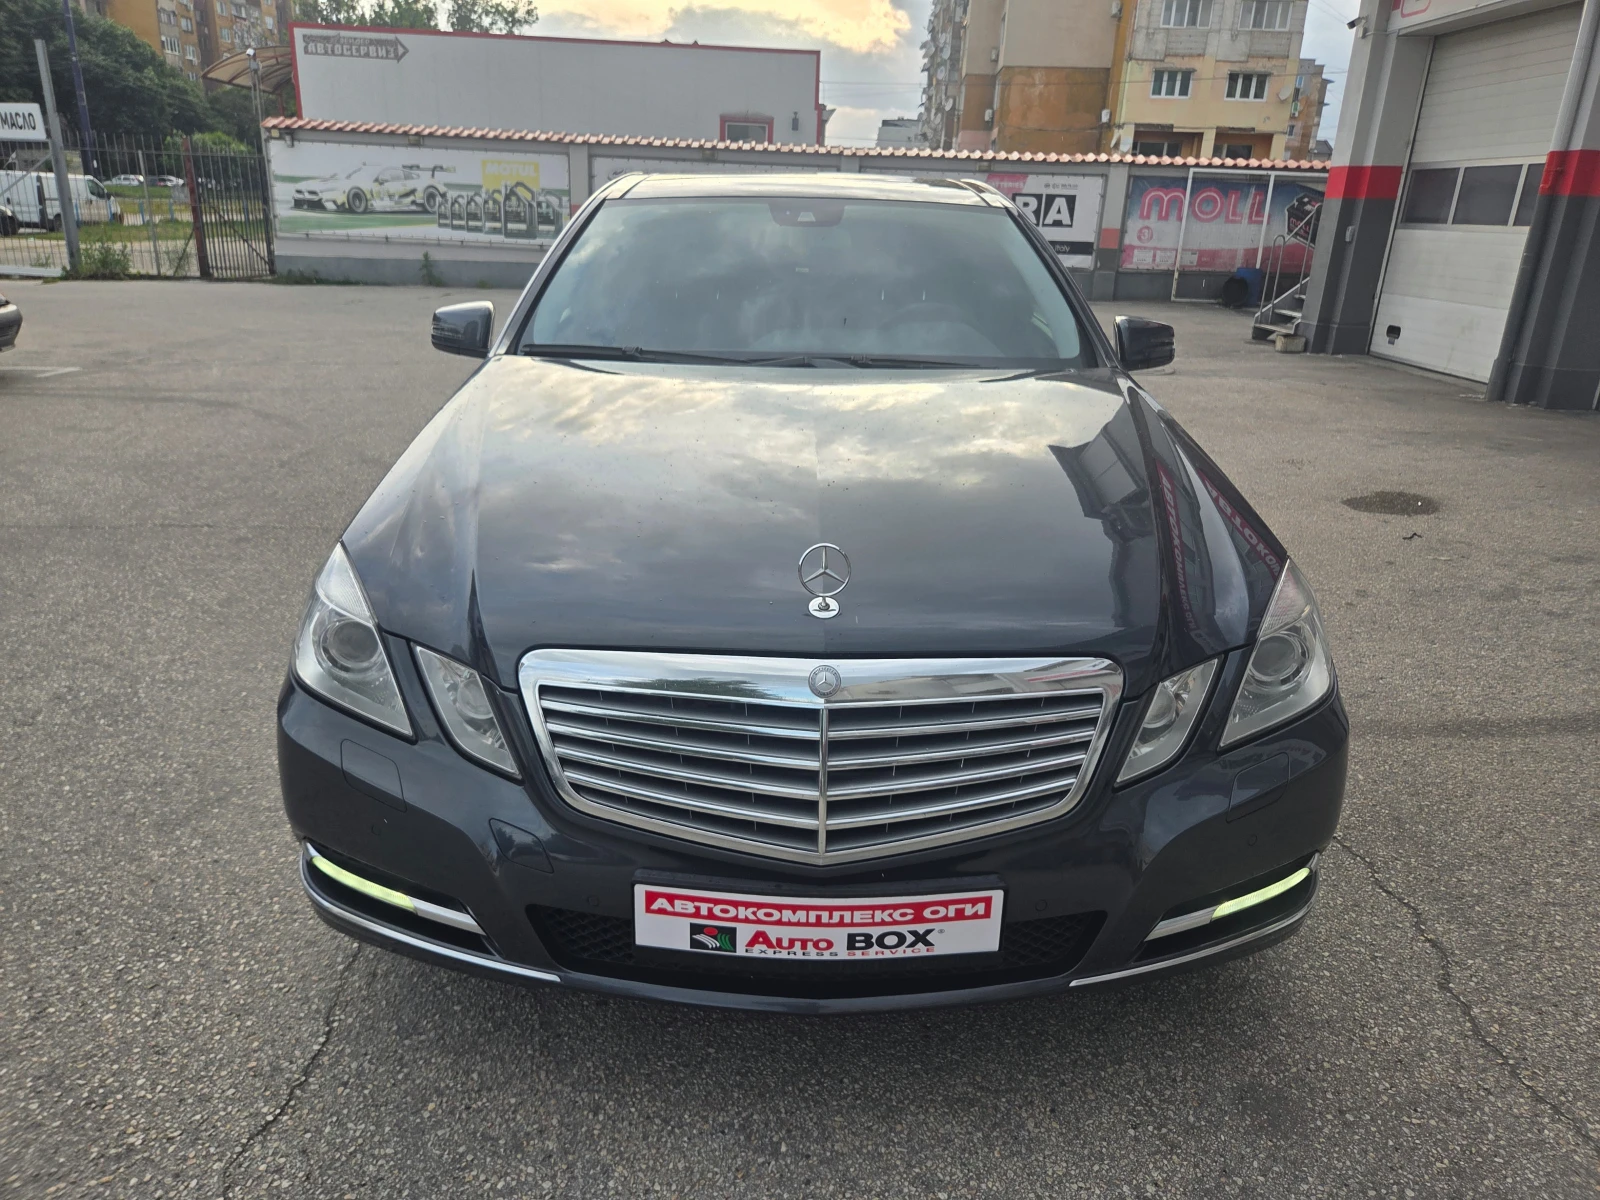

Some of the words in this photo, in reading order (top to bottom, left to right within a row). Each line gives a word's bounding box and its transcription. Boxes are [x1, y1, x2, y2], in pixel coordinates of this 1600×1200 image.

[307, 42, 396, 58] АВТОСЕРВИЗ
[0, 111, 37, 131] МАСЛО
[485, 162, 538, 177] MOTUL
[1138, 186, 1271, 224] MOLL
[650, 897, 915, 924] АВТОКОМПЛЕКС
[922, 902, 986, 919] ОГИ
[744, 948, 839, 957] EXPRESS
[846, 946, 936, 957] SERVICE
